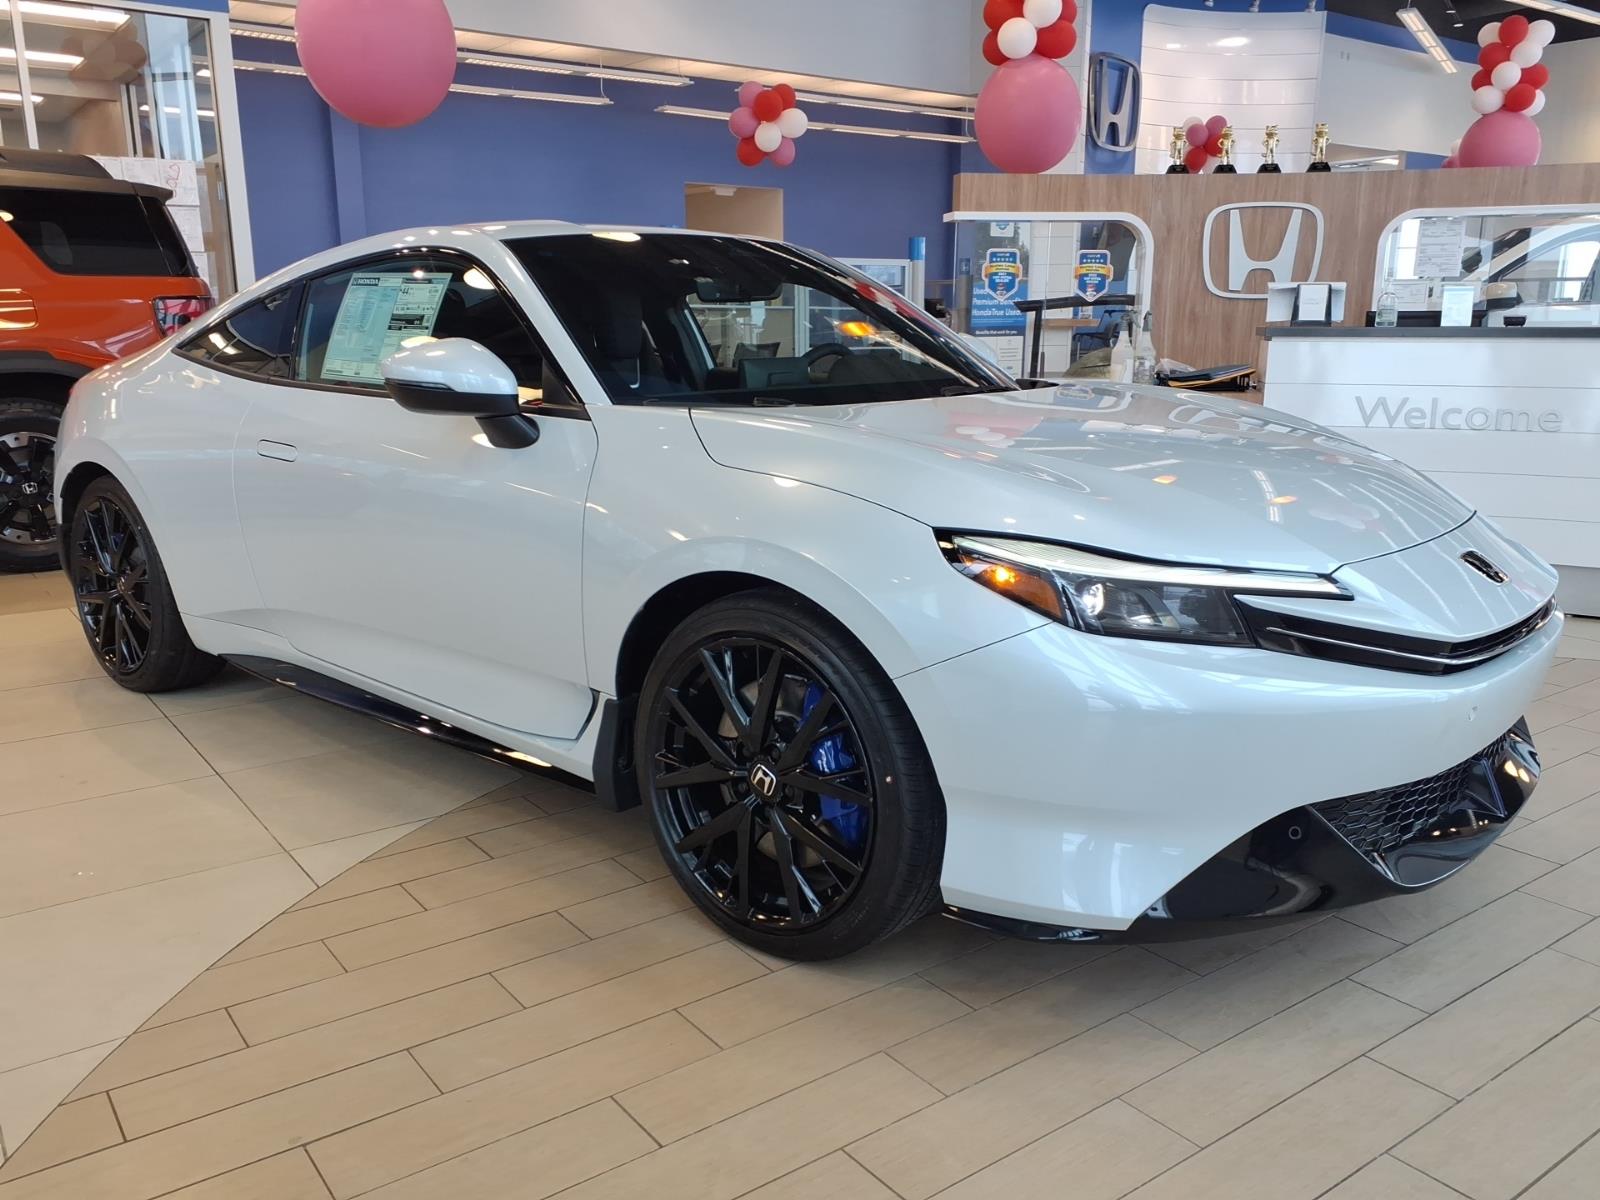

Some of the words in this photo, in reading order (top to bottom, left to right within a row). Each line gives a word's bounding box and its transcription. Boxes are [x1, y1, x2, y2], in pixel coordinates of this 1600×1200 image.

[971, 308, 991, 316] Honda
[991, 308, 1004, 316] True
[1354, 395, 1562, 432] Welcome
